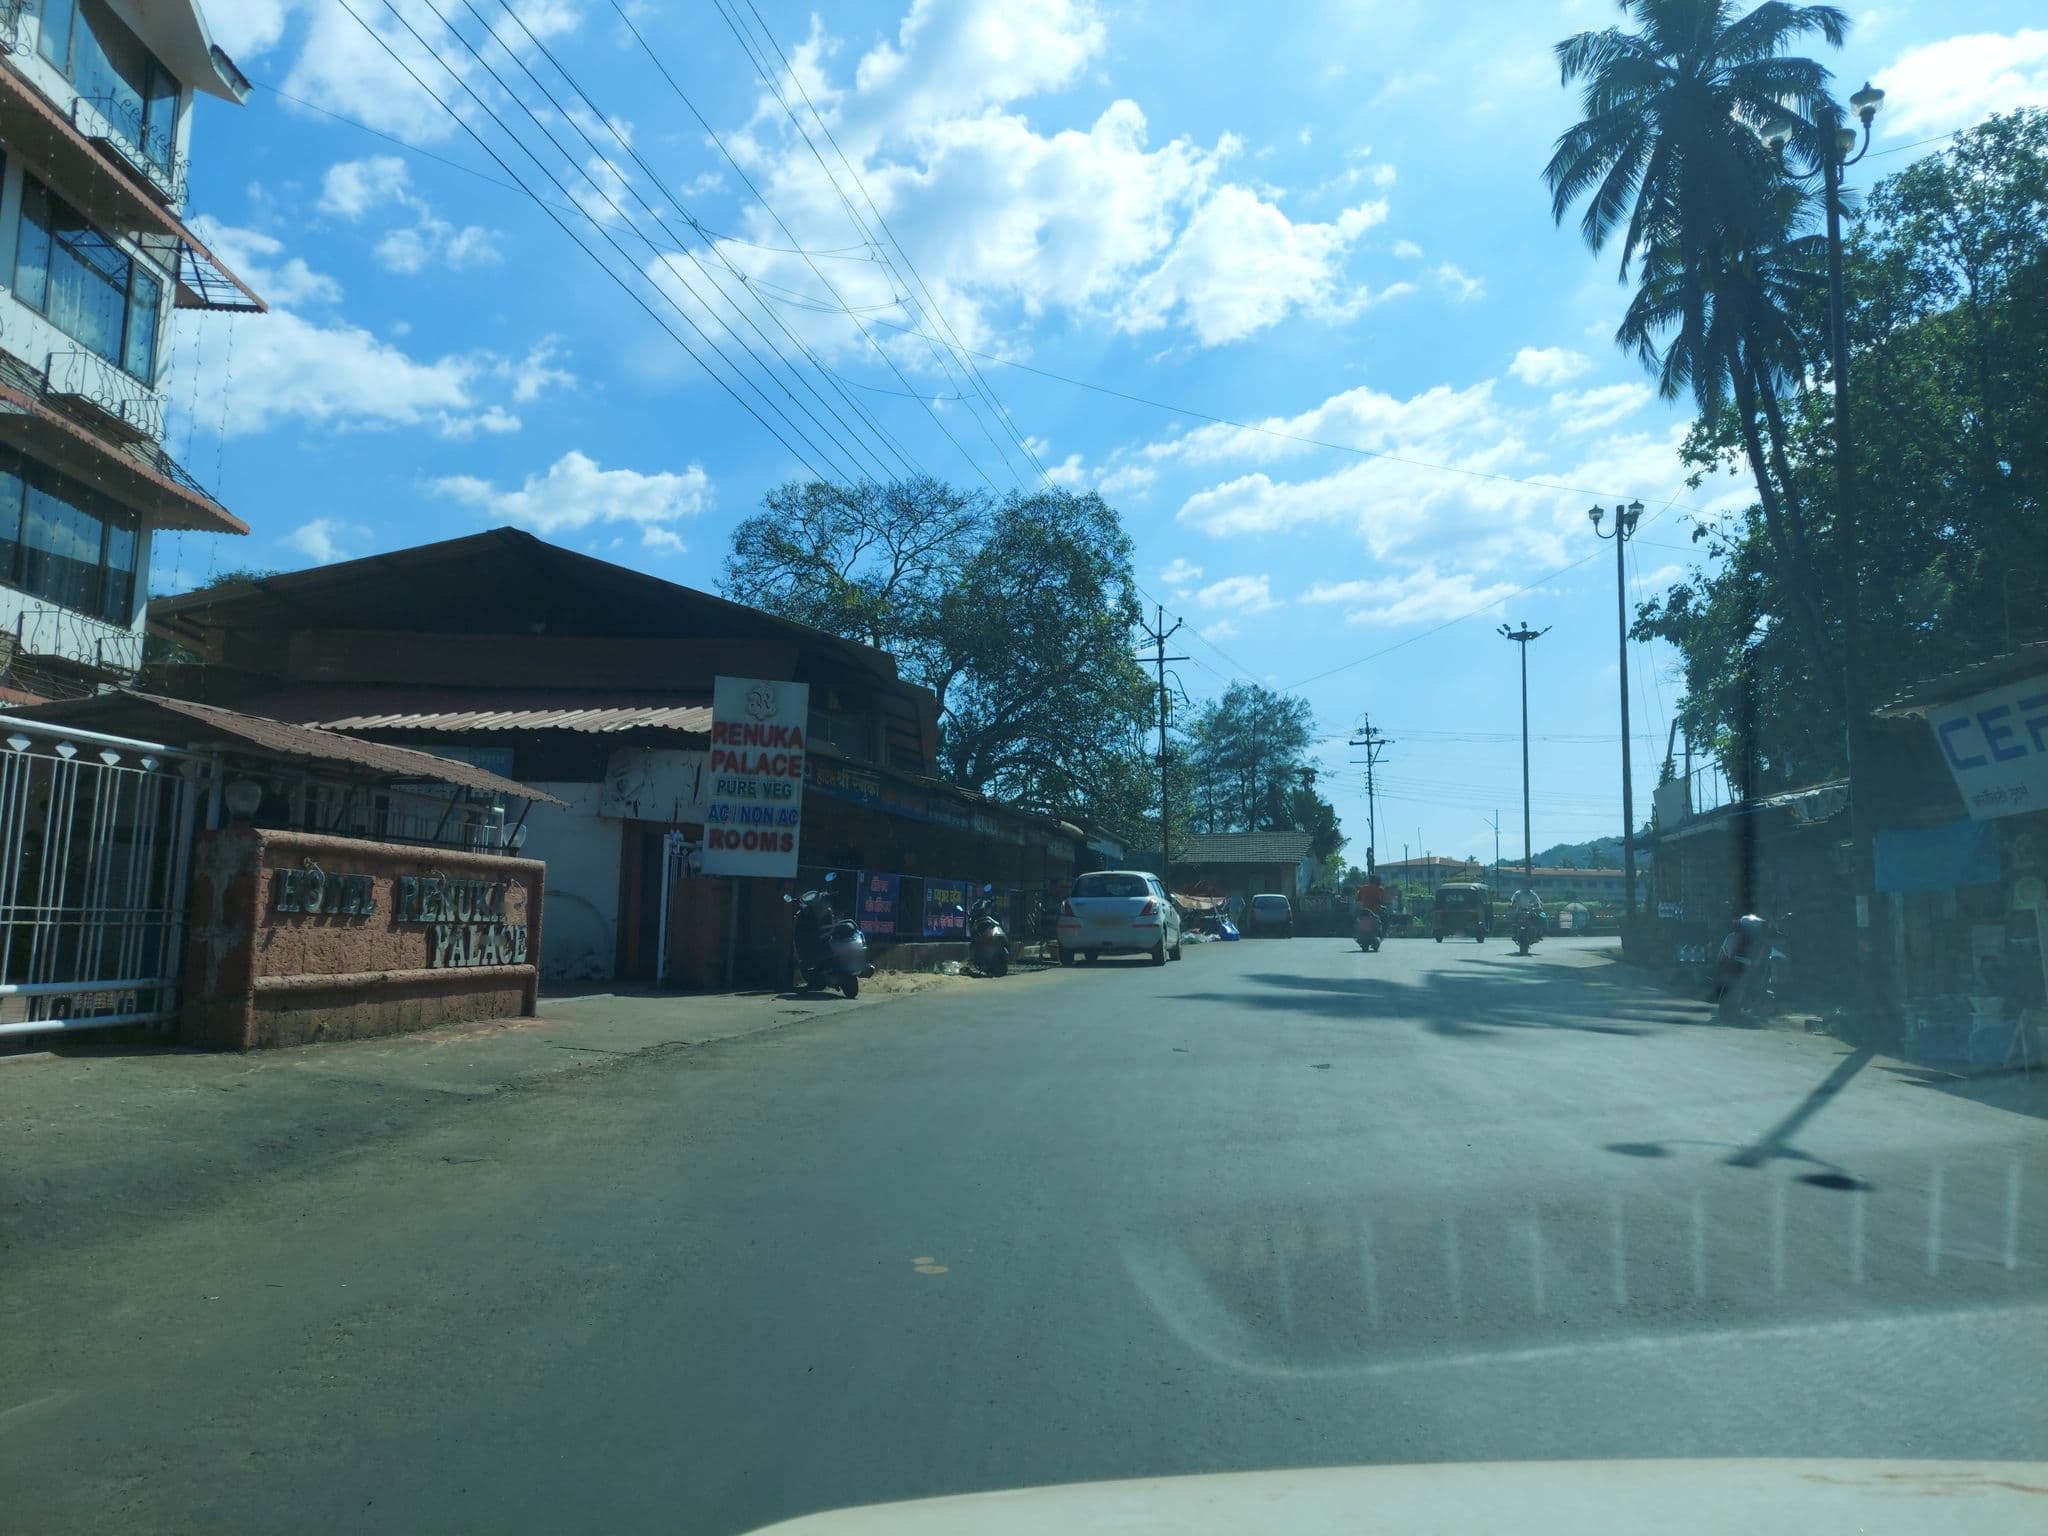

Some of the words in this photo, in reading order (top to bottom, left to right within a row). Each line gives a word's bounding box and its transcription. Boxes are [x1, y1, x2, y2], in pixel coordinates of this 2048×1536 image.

[712, 721, 804, 749] RENUKA
[711, 751, 802, 778] PALACE
[717, 780, 757, 798] PURE
[763, 782, 793, 799] VEG
[740, 806, 775, 825] NON
[778, 808, 798, 826] AC
[709, 828, 794, 852] ROOMS
[432, 924, 528, 969] PALACE
